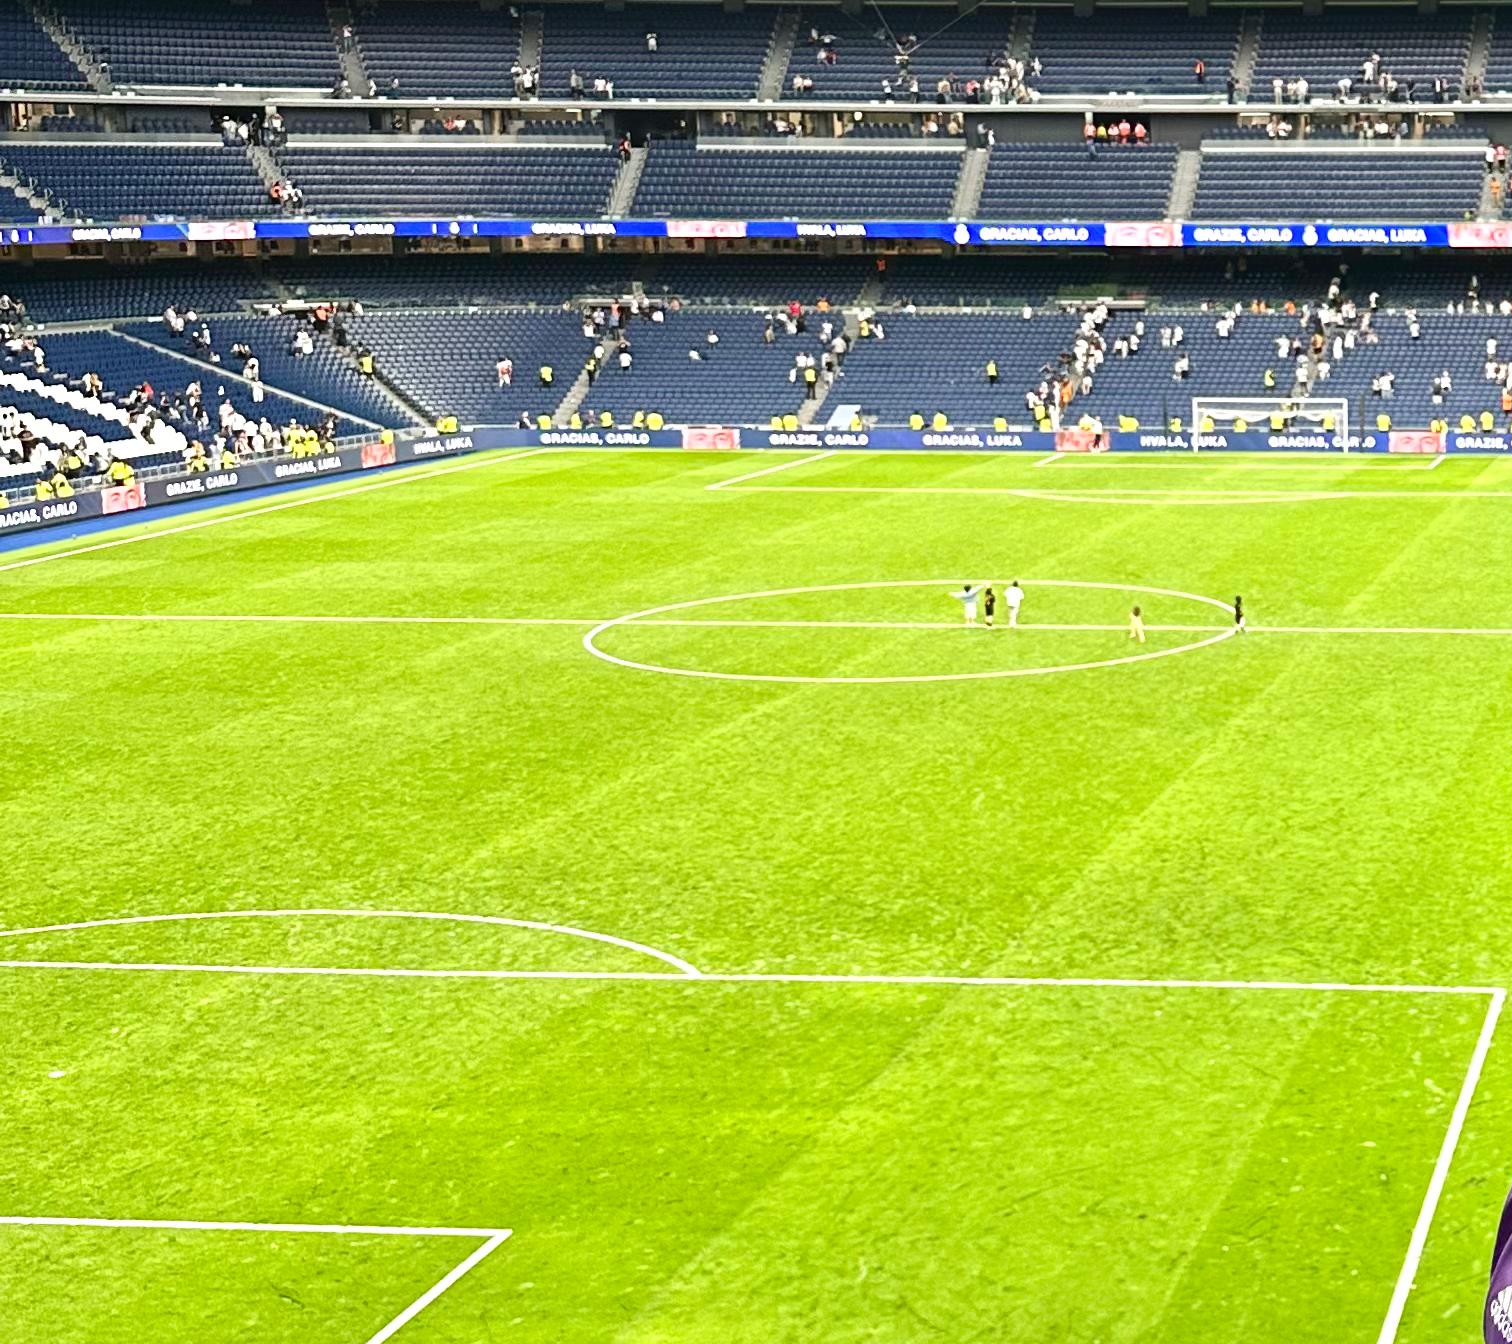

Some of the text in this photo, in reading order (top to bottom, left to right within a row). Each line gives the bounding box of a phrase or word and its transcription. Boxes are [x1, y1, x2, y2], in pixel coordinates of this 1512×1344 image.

[540, 433, 650, 446] GRACIAS, CARLO
[825, 434, 869, 446] CARLO
[922, 434, 1022, 447] GRACIAS, LUKA
[1140, 436, 1188, 448] HVALA,
[1268, 436, 1329, 449] GRACIAS,
[318, 457, 342, 470] LUKA
[206, 472, 238, 490] CARLO
[0, 501, 78, 528] RACIAS, CARLO
